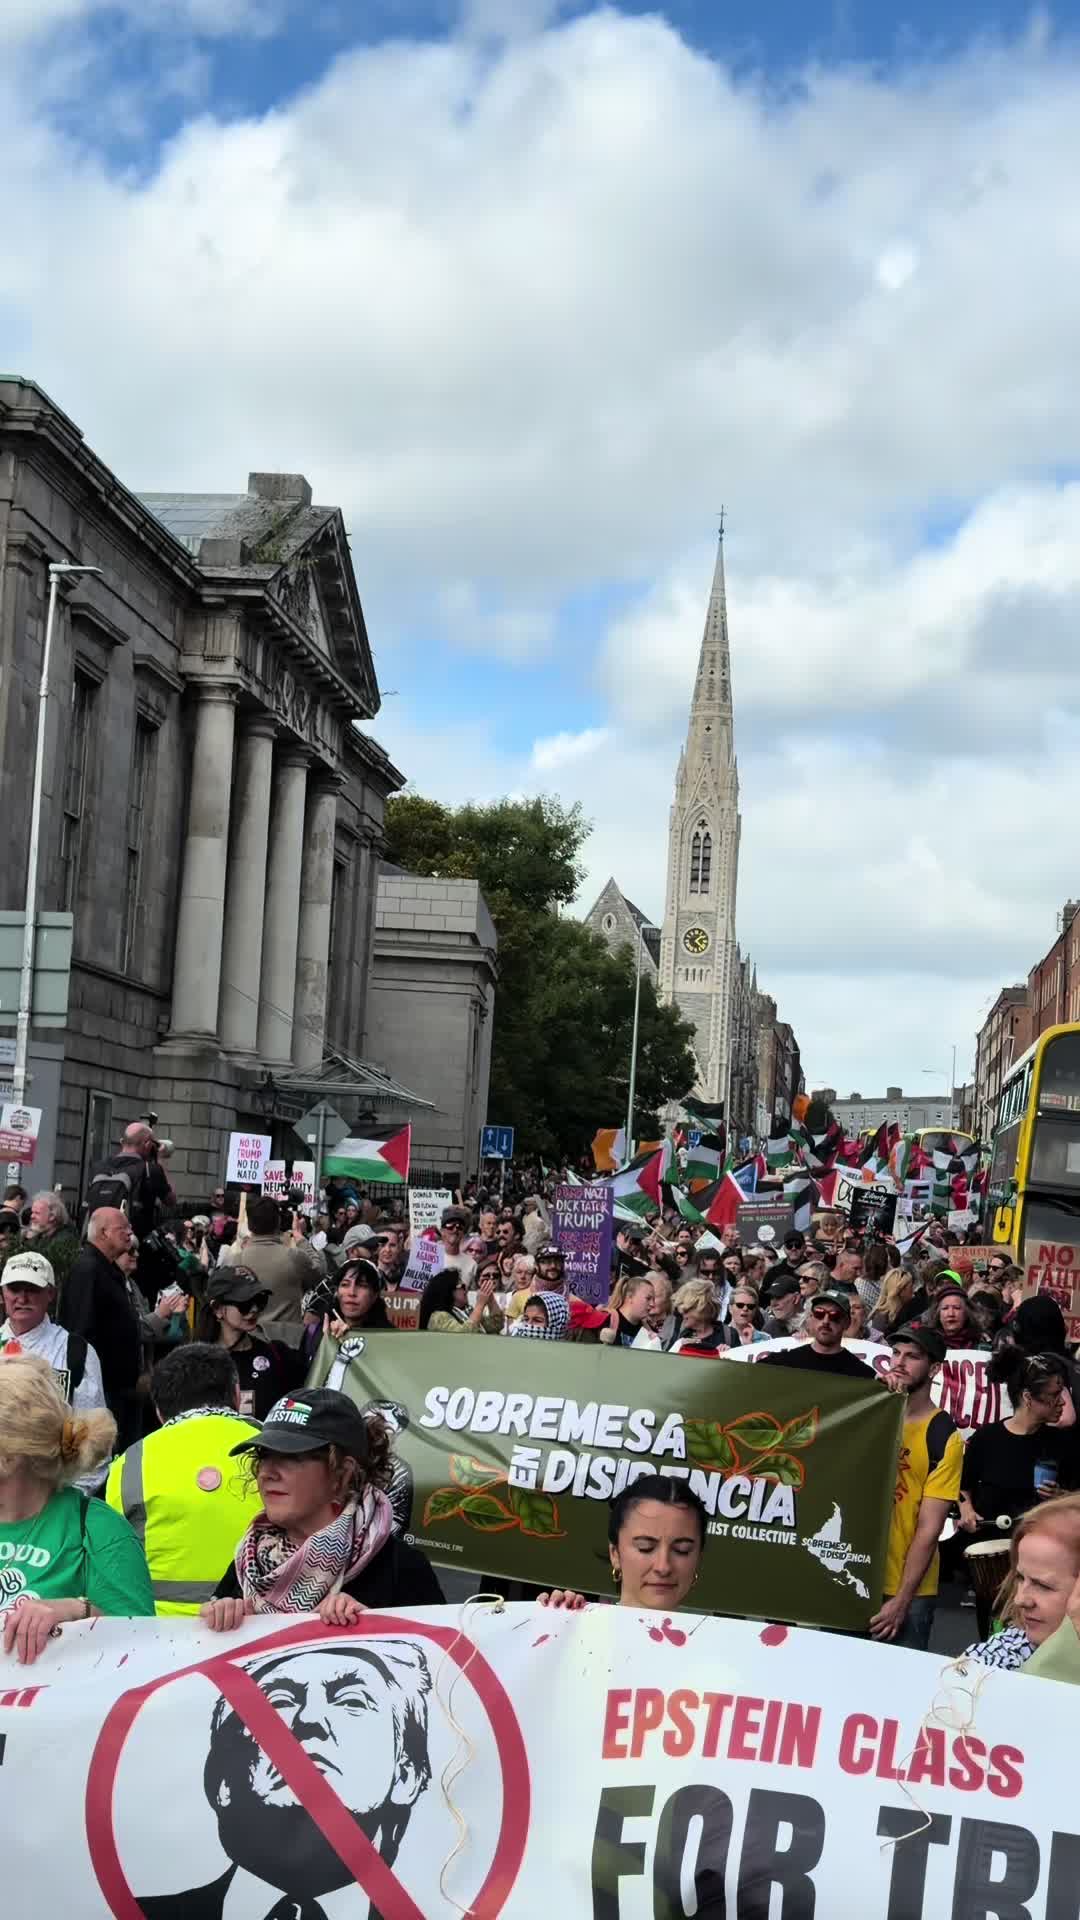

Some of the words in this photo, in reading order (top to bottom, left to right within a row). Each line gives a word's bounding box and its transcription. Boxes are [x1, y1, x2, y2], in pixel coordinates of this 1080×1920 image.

[239, 1139, 249, 1147] NO
[252, 1139, 261, 1149] TO
[237, 1148, 262, 1159] TRUMP
[237, 1160, 247, 1169] NO
[250, 1160, 259, 1169] TO
[237, 1170, 257, 1180] NATO
[264, 1169, 284, 1181] SAVE
[290, 1171, 304, 1182] UR
[434, 1191, 450, 1199] TRUMP
[584, 1187, 608, 1200] NAZI
[556, 1212, 605, 1229] TRUMP
[420, 1240, 438, 1254] STRIKE
[416, 1251, 440, 1264] AGAINST
[562, 1251, 576, 1261] OT
[583, 1252, 600, 1263] MY
[1038, 1244, 1074, 1266] NO
[405, 1267, 434, 1281] BILLIONA
[421, 1261, 433, 1273] THE
[564, 1262, 599, 1273] MONKEY
[1027, 1263, 1080, 1290] FÁILT
[384, 1296, 420, 1310] RUMP
[419, 1386, 688, 1459] SOBREMESA
[508, 1444, 544, 1490] EN
[542, 1450, 797, 1528] DISINCIA
[731, 1525, 797, 1546] COLLECTIVE
[802, 1537, 852, 1553] SOBREMESA
[0, 1541, 50, 1567] OUD
[826, 1550, 872, 1564] DISIDENCIA
[601, 1687, 823, 1769] EPSTEIN
[837, 1712, 1025, 1799] CLASS
[590, 1784, 826, 1920] FOR
